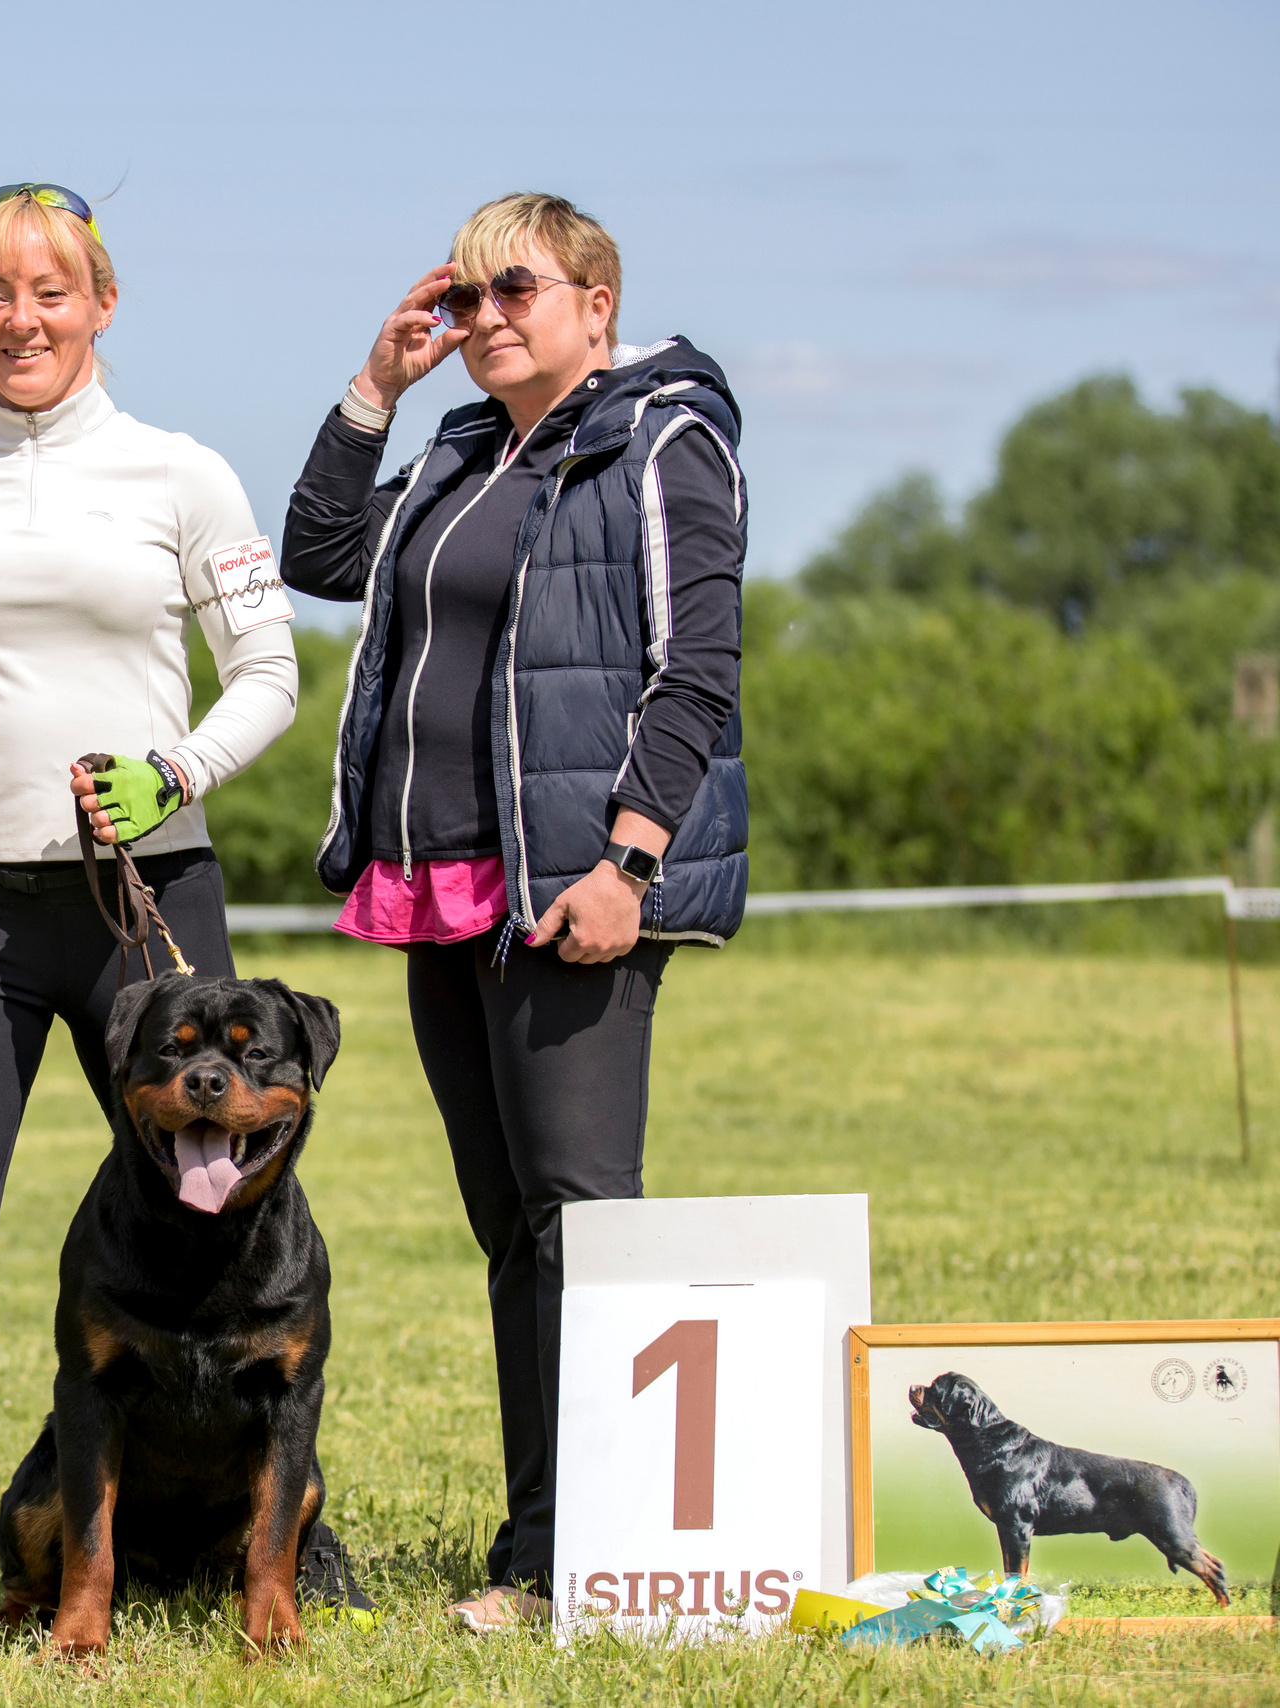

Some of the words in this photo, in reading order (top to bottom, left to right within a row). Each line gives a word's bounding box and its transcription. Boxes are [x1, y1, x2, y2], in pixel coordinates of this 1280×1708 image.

[219, 556, 250, 573] ROYAL
[250, 550, 271, 563] CANIN
[243, 567, 265, 608] 5
[632, 1319, 718, 1530] 1
[568, 1573, 577, 1617] PREMIUM
